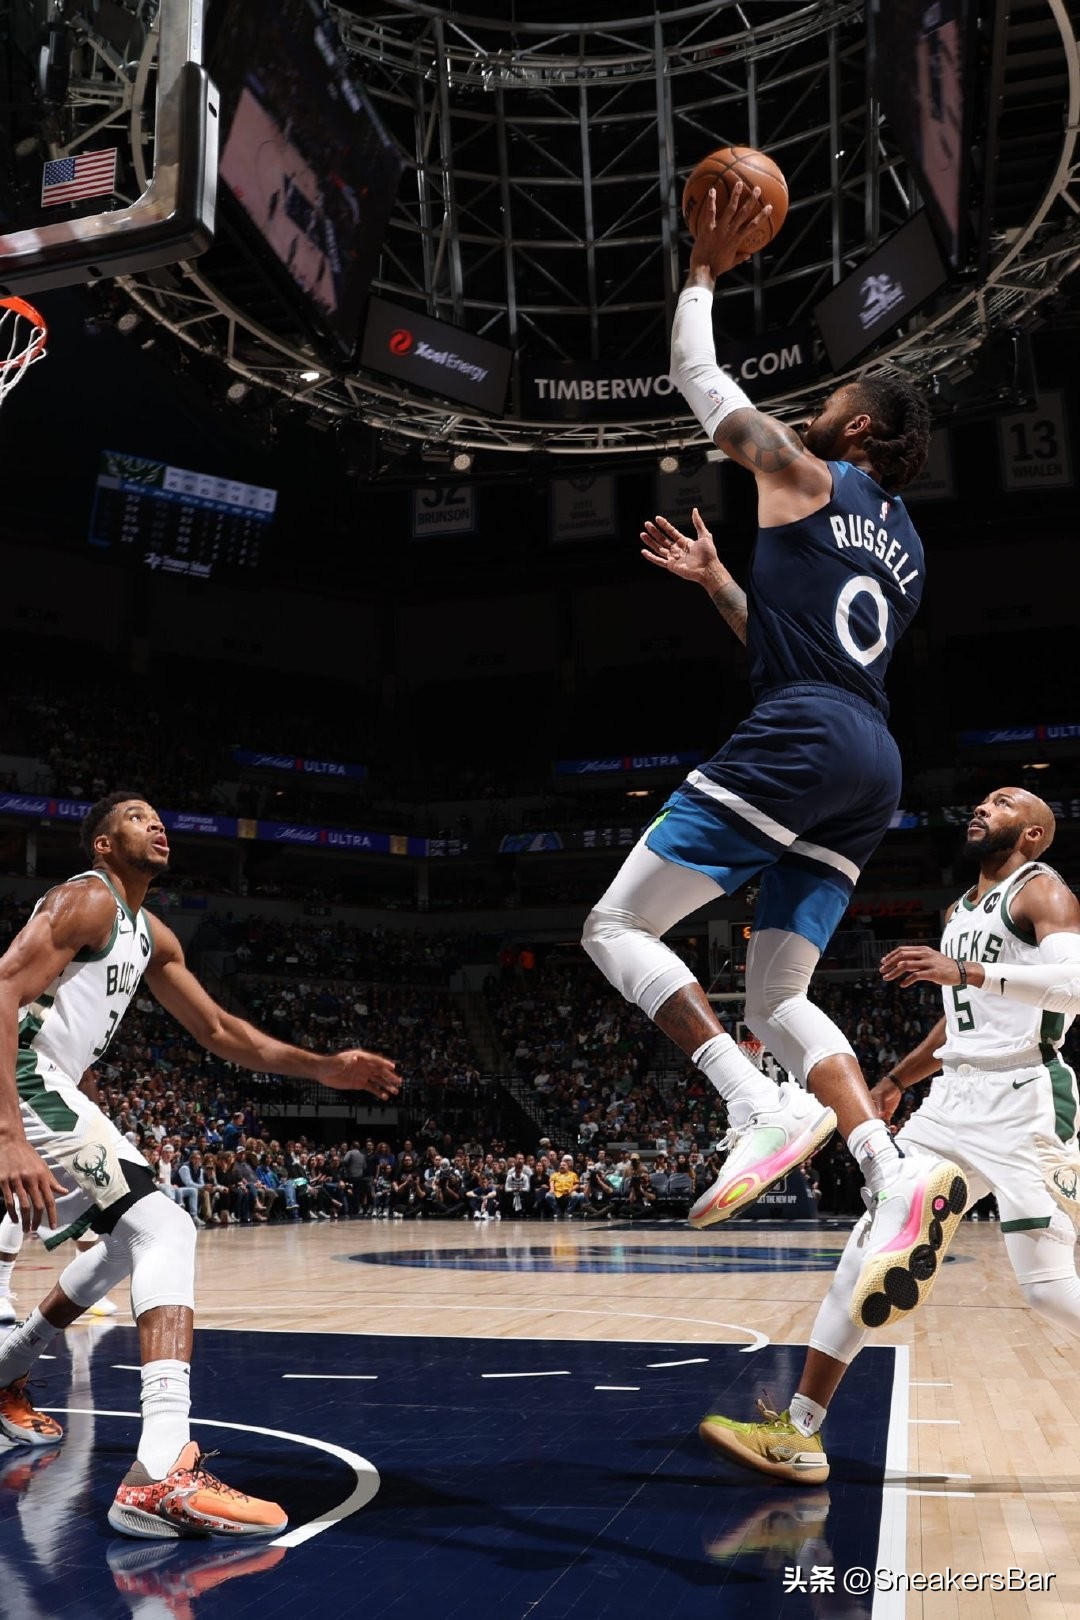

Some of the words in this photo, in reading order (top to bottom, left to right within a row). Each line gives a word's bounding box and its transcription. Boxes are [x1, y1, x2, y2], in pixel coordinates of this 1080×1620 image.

[534, 343, 803, 401] TIMBERWOS.COM
[1010, 420, 1058, 462] 13
[1012, 463, 1062, 478] WHALEN
[417, 508, 470, 525] BRUNSON
[829, 514, 919, 595] RUSSELL
[835, 575, 889, 667] 0
[1047, 725, 1080, 738] ULT
[303, 760, 347, 776] ULTRA
[632, 755, 681, 769] ULTRA
[58, 802, 93, 819] ULT
[327, 831, 372, 848] ULTRA
[945, 930, 1004, 963] UCKS
[106, 961, 142, 998] BUCK
[952, 985, 976, 1032] 5
[787, 1195, 797, 1204] APP
